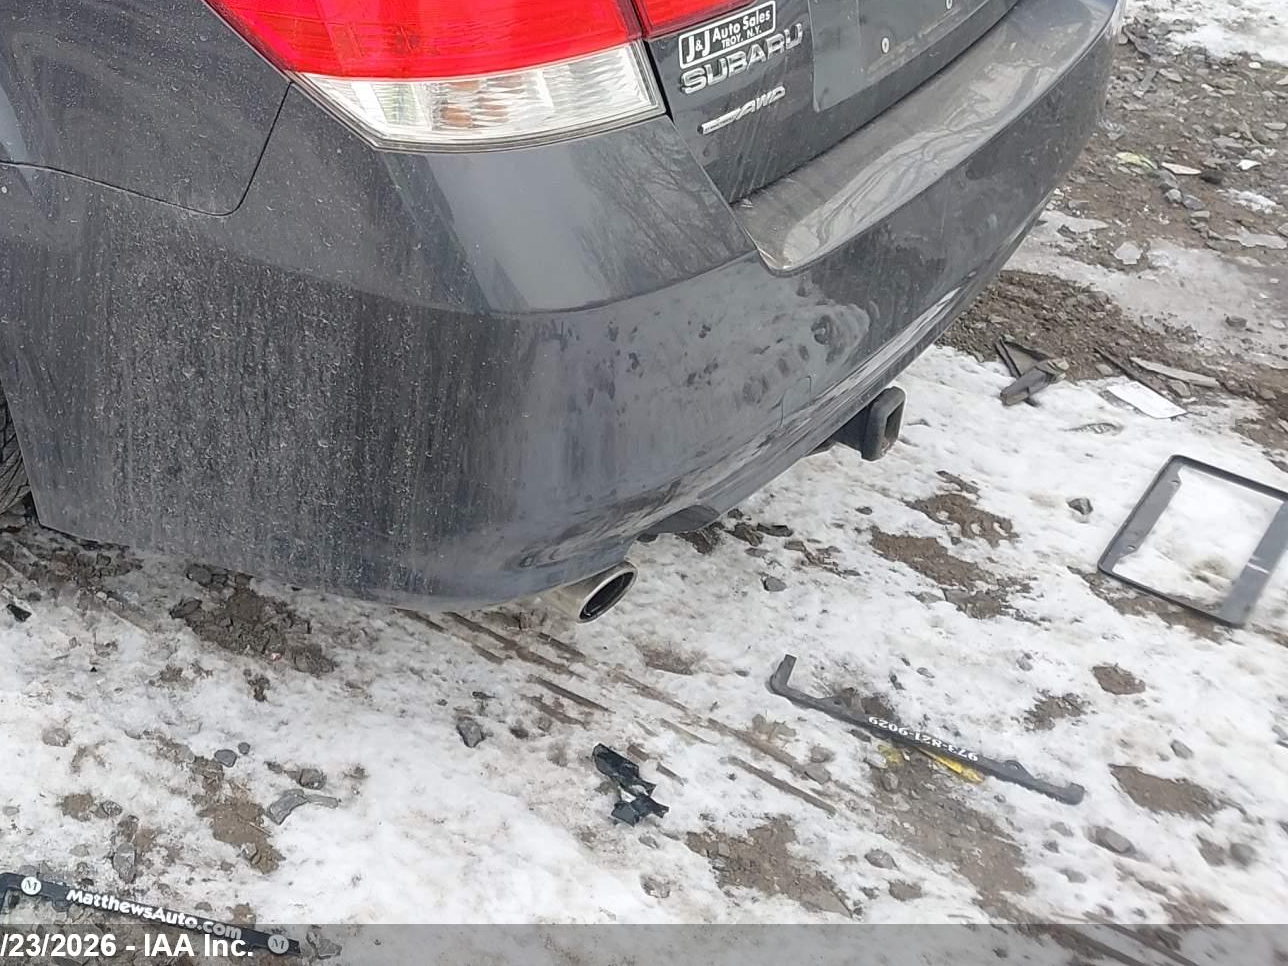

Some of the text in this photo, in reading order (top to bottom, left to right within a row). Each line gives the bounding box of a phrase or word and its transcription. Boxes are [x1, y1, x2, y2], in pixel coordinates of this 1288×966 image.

[679, 22, 803, 95] SUBARU
[685, 9, 771, 63] J&J Auto Sales
[735, 85, 786, 121] AWD
[868, 715, 979, 762] 973-821-9029
[65, 888, 243, 940] MatthewsAuto.com
